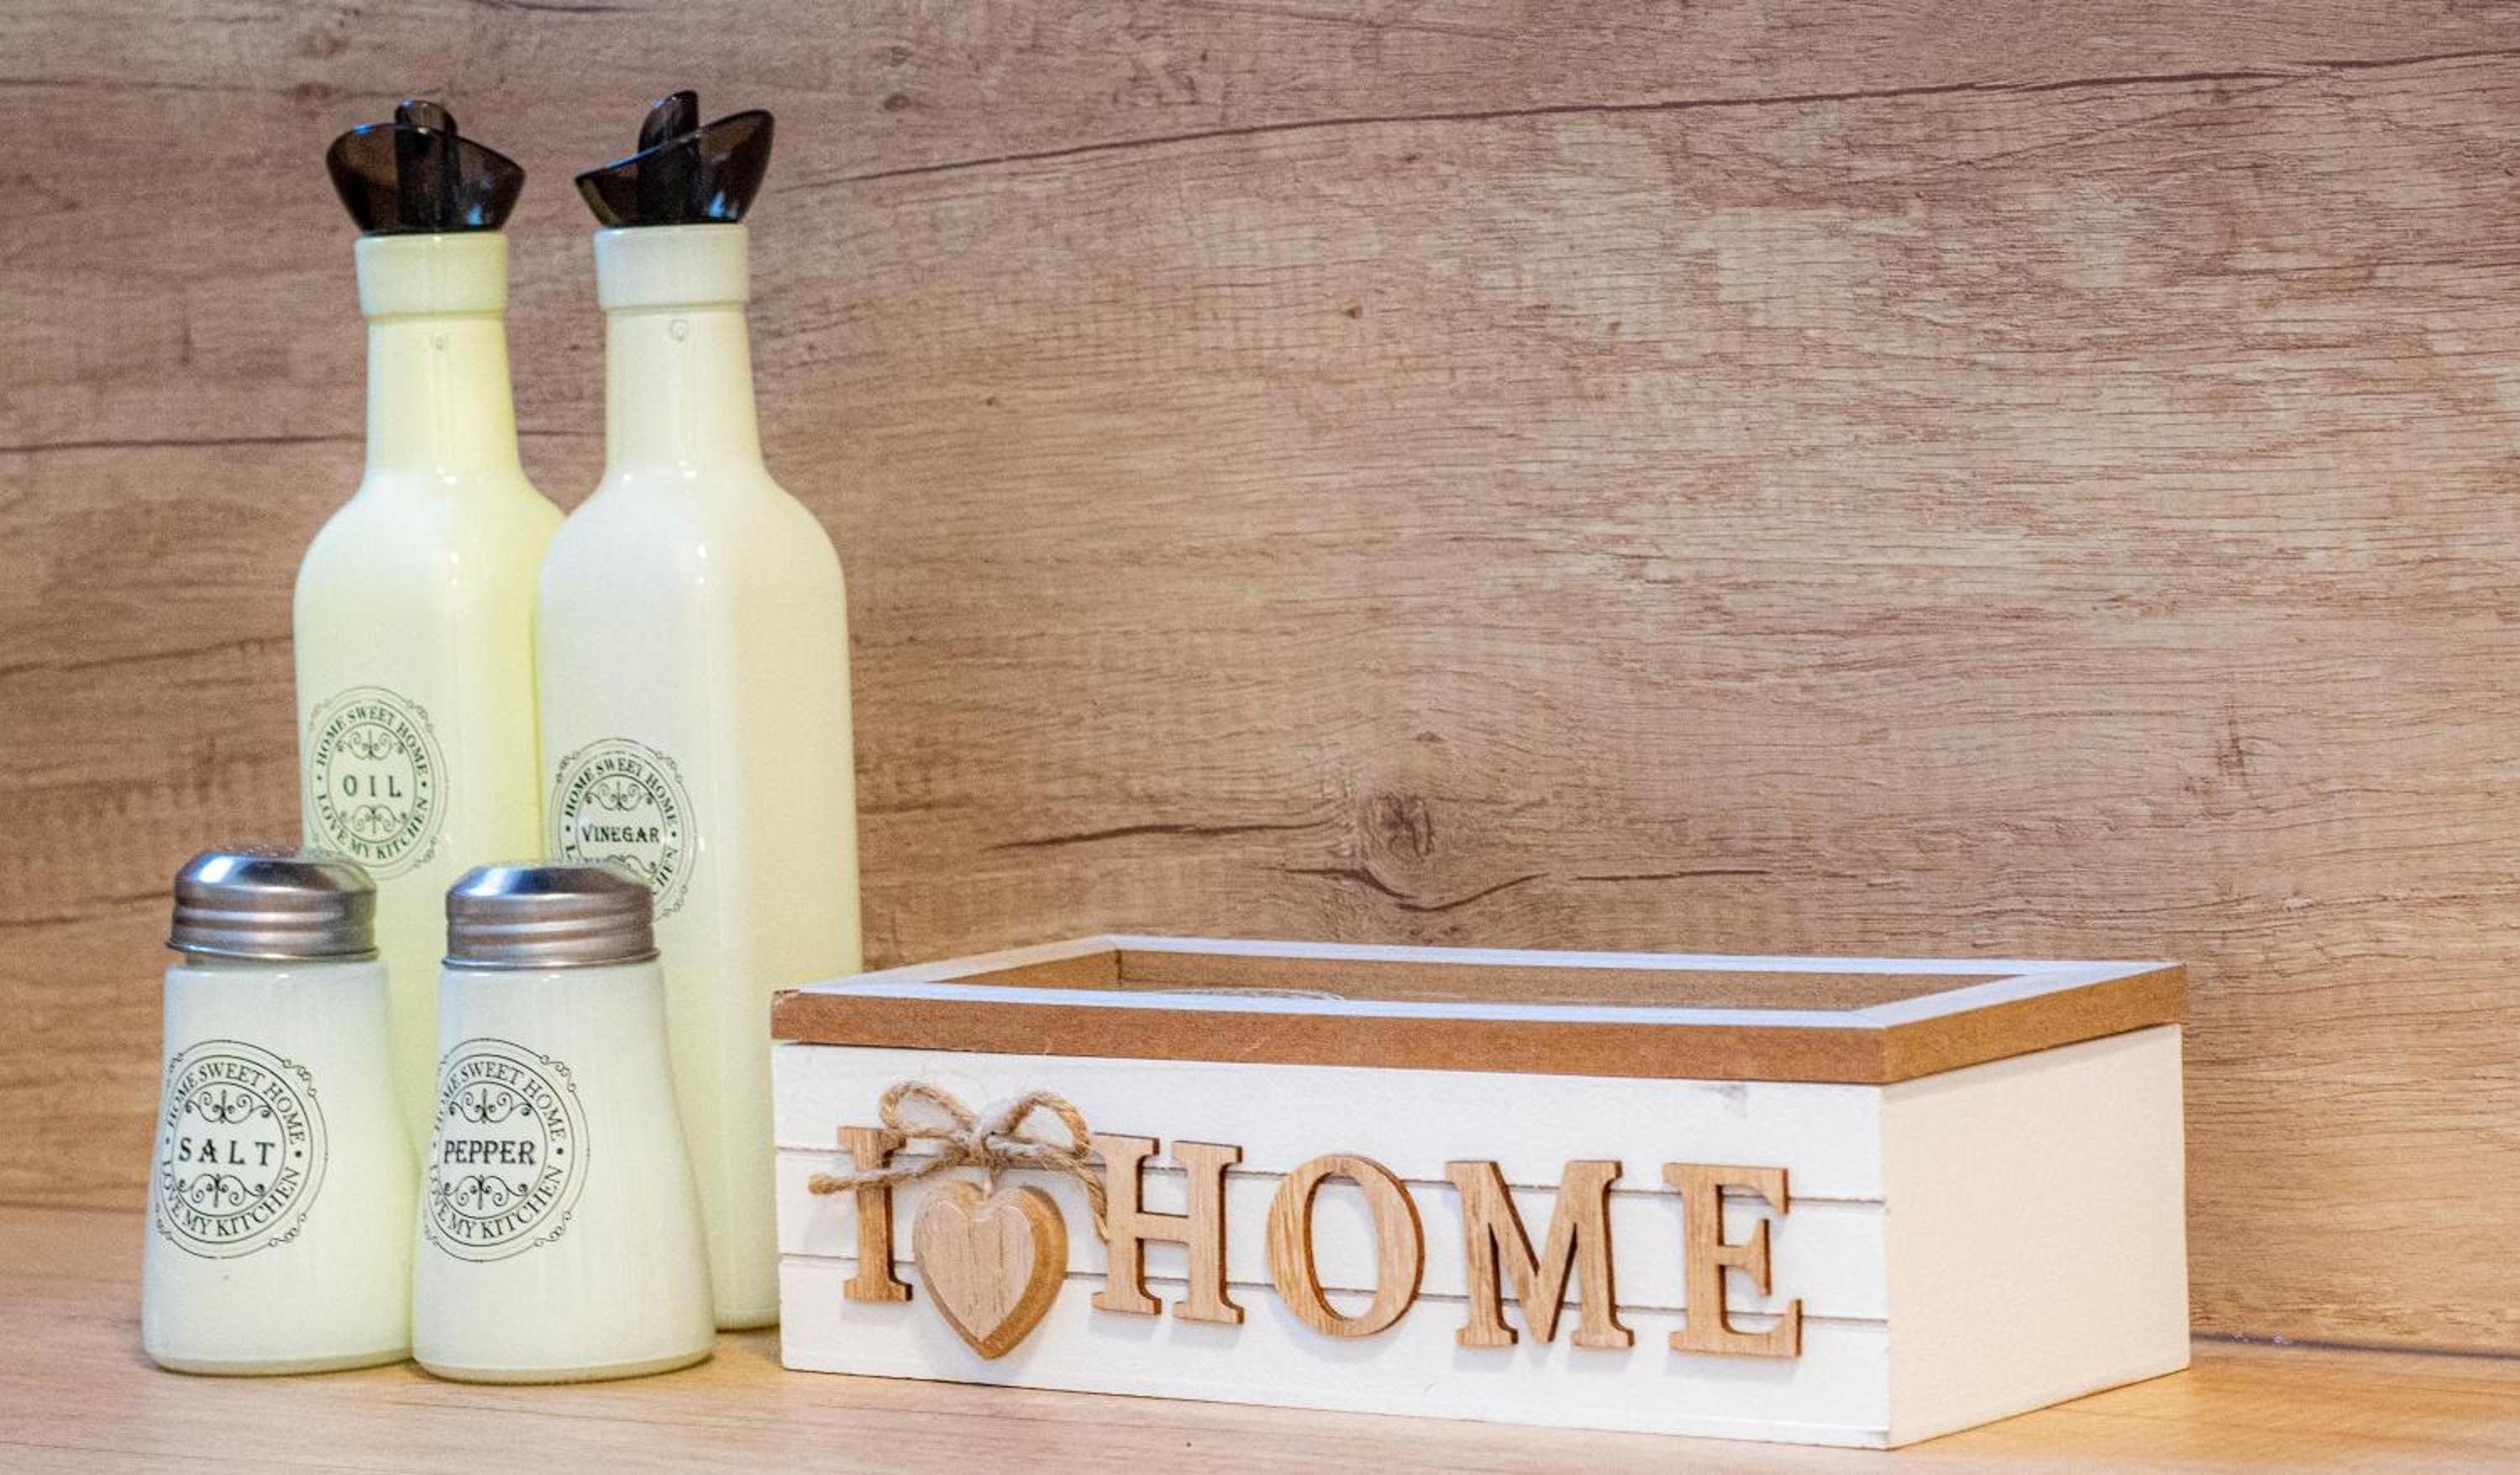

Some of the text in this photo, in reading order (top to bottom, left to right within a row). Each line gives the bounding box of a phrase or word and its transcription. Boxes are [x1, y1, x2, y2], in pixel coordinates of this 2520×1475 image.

[317, 706, 428, 776] HOME SWEET HOME
[343, 774, 402, 797] OIL
[564, 758, 678, 827] HOME SWEET HOME
[317, 794, 428, 859] LOVE MY KITCHEN
[582, 826, 660, 843] VINEGAR
[167, 1062, 306, 1145] HOME SWEET HOME
[459, 1061, 526, 1085] SWEET
[522, 1078, 566, 1142] HOME
[178, 1136, 276, 1167] SALT
[444, 1139, 537, 1166] PEPPER
[181, 1210, 213, 1236] MY
[216, 1167, 302, 1237] KITCHEN
[448, 1215, 477, 1239] MY
[480, 1164, 564, 1239] KITCHEN
[838, 1126, 1803, 1358] I HOME
